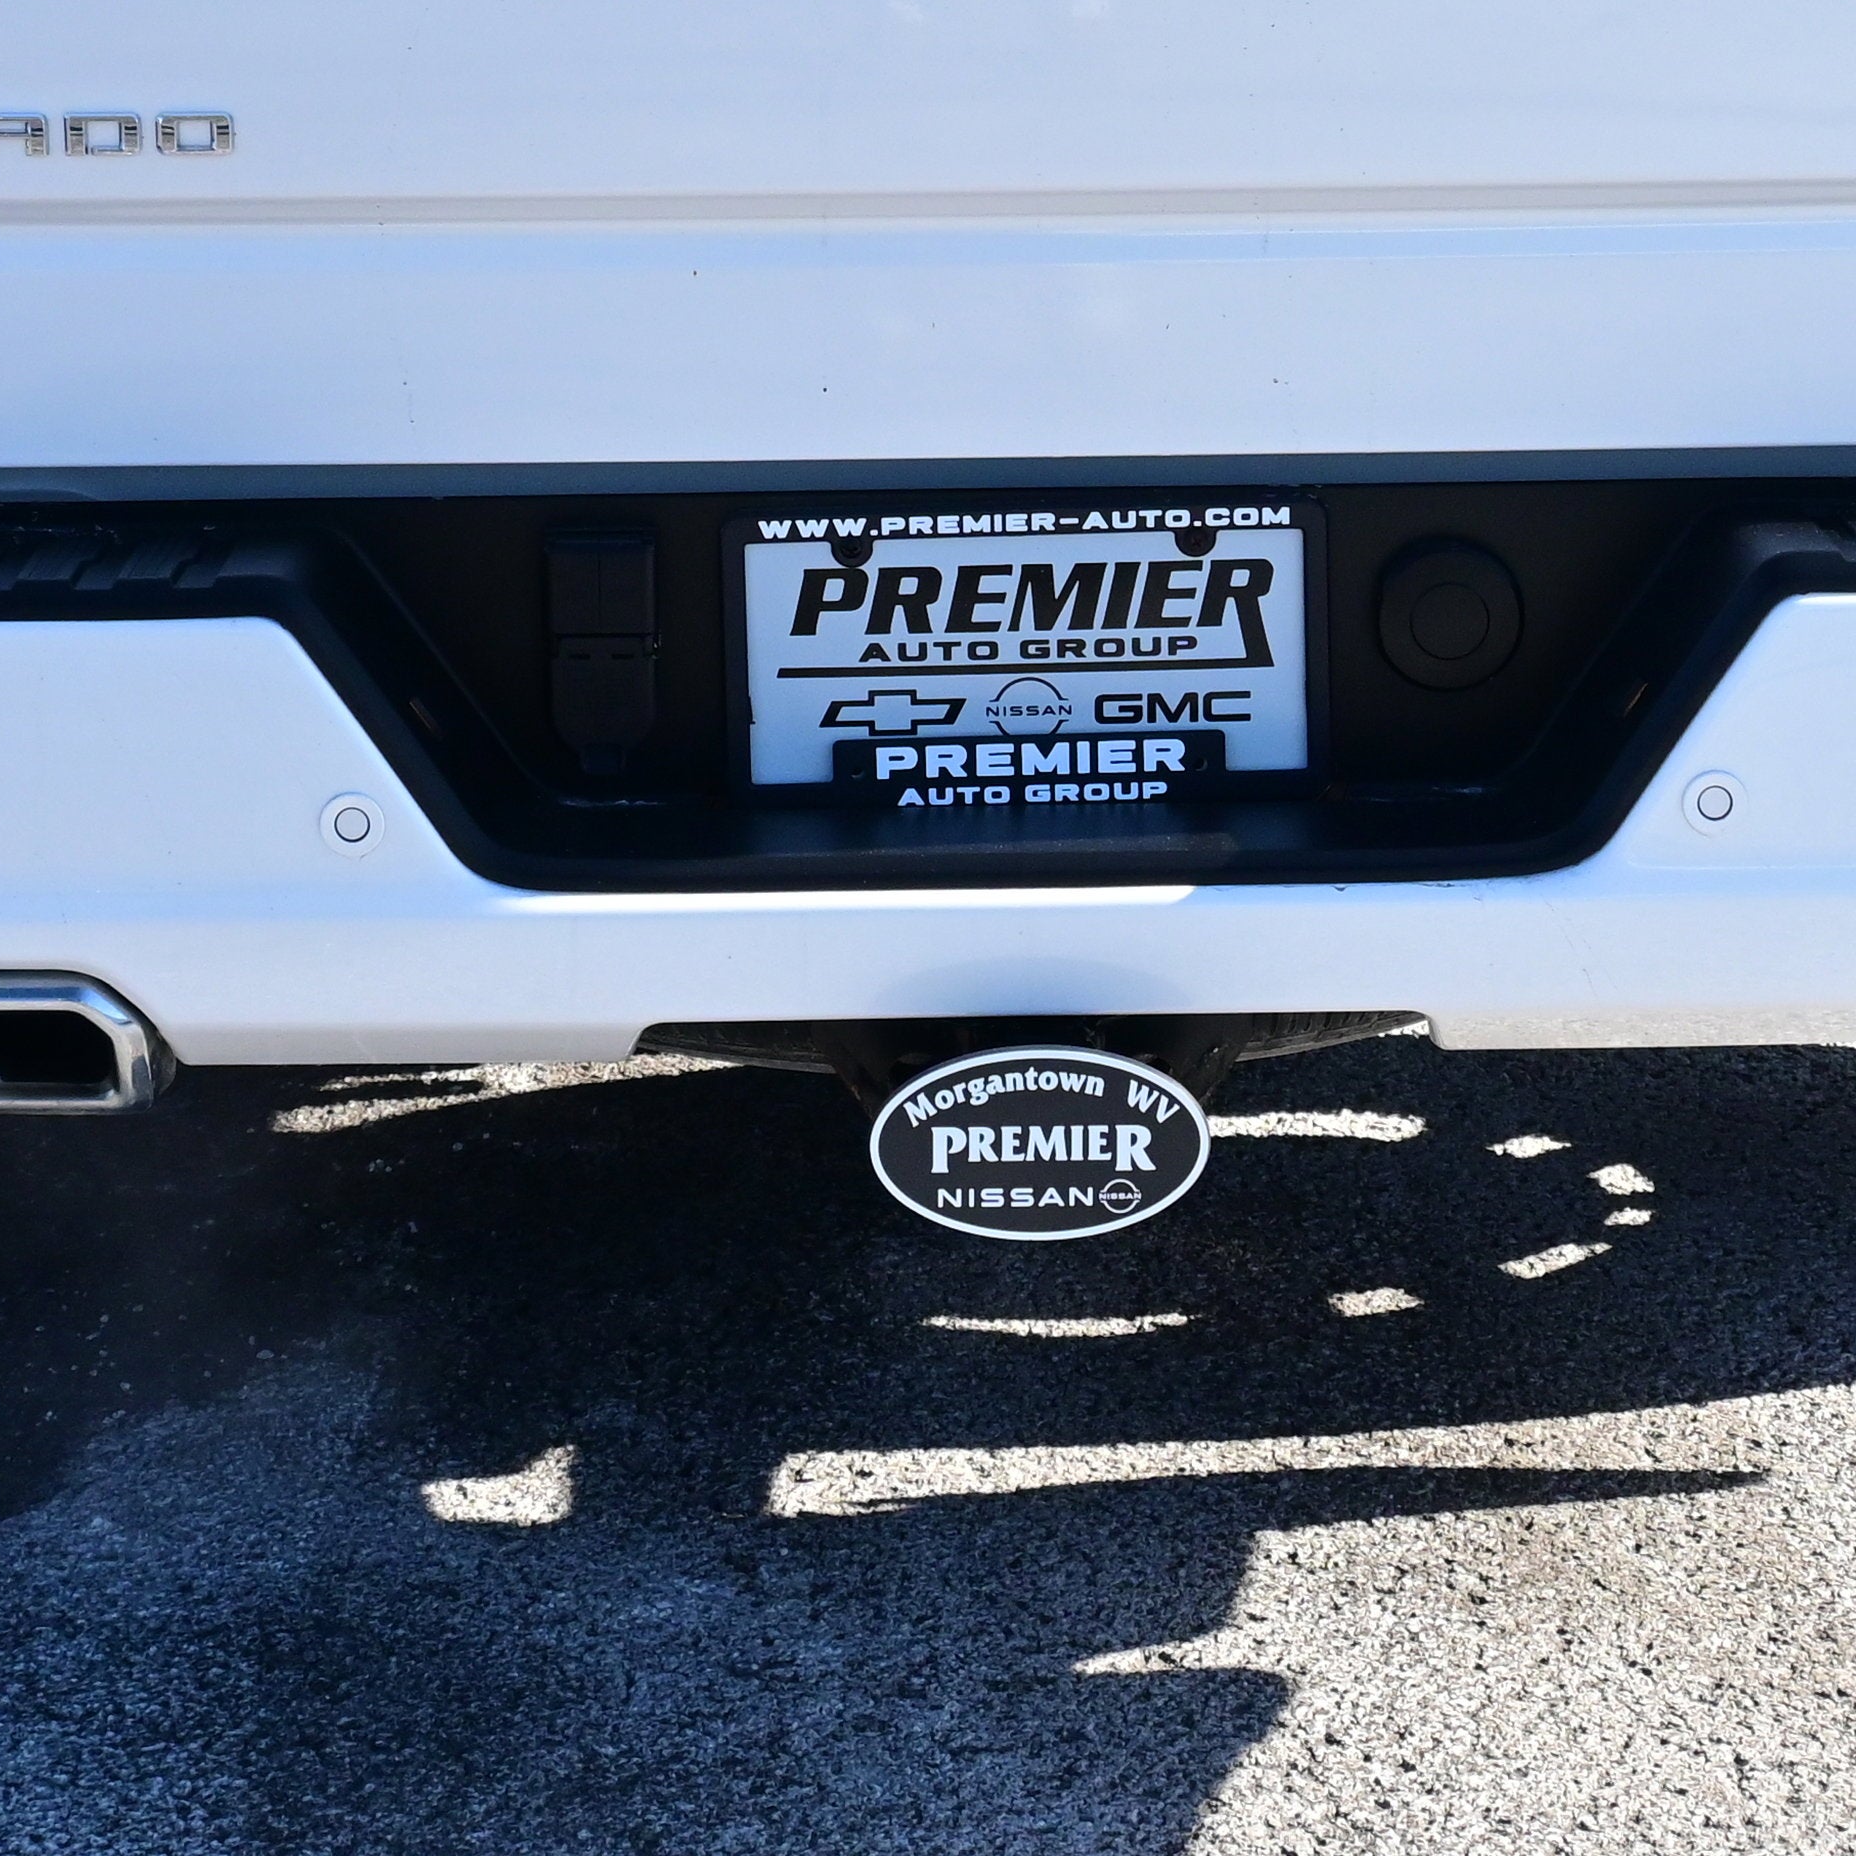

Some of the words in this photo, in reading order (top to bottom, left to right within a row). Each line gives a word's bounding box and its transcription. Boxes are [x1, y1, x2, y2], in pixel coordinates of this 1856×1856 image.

[758, 506, 1291, 540] WWW.PREMIER-AUTO.COM
[789, 558, 1274, 667] PREMIER
[858, 640, 999, 663] AUTO
[1019, 636, 1198, 661] GROUP
[985, 702, 1073, 718] NISSAN
[1094, 690, 1252, 724] GMC
[875, 738, 1187, 781] PREMIER
[897, 785, 1008, 807] AUTO
[1024, 780, 1168, 804] GROUP
[902, 1065, 1105, 1128] Morgantown
[1126, 1078, 1181, 1125] WV
[930, 1123, 1157, 1174] PREMIER
[937, 1186, 1095, 1209] NISSAN
[1098, 1191, 1142, 1201] NISSAN
